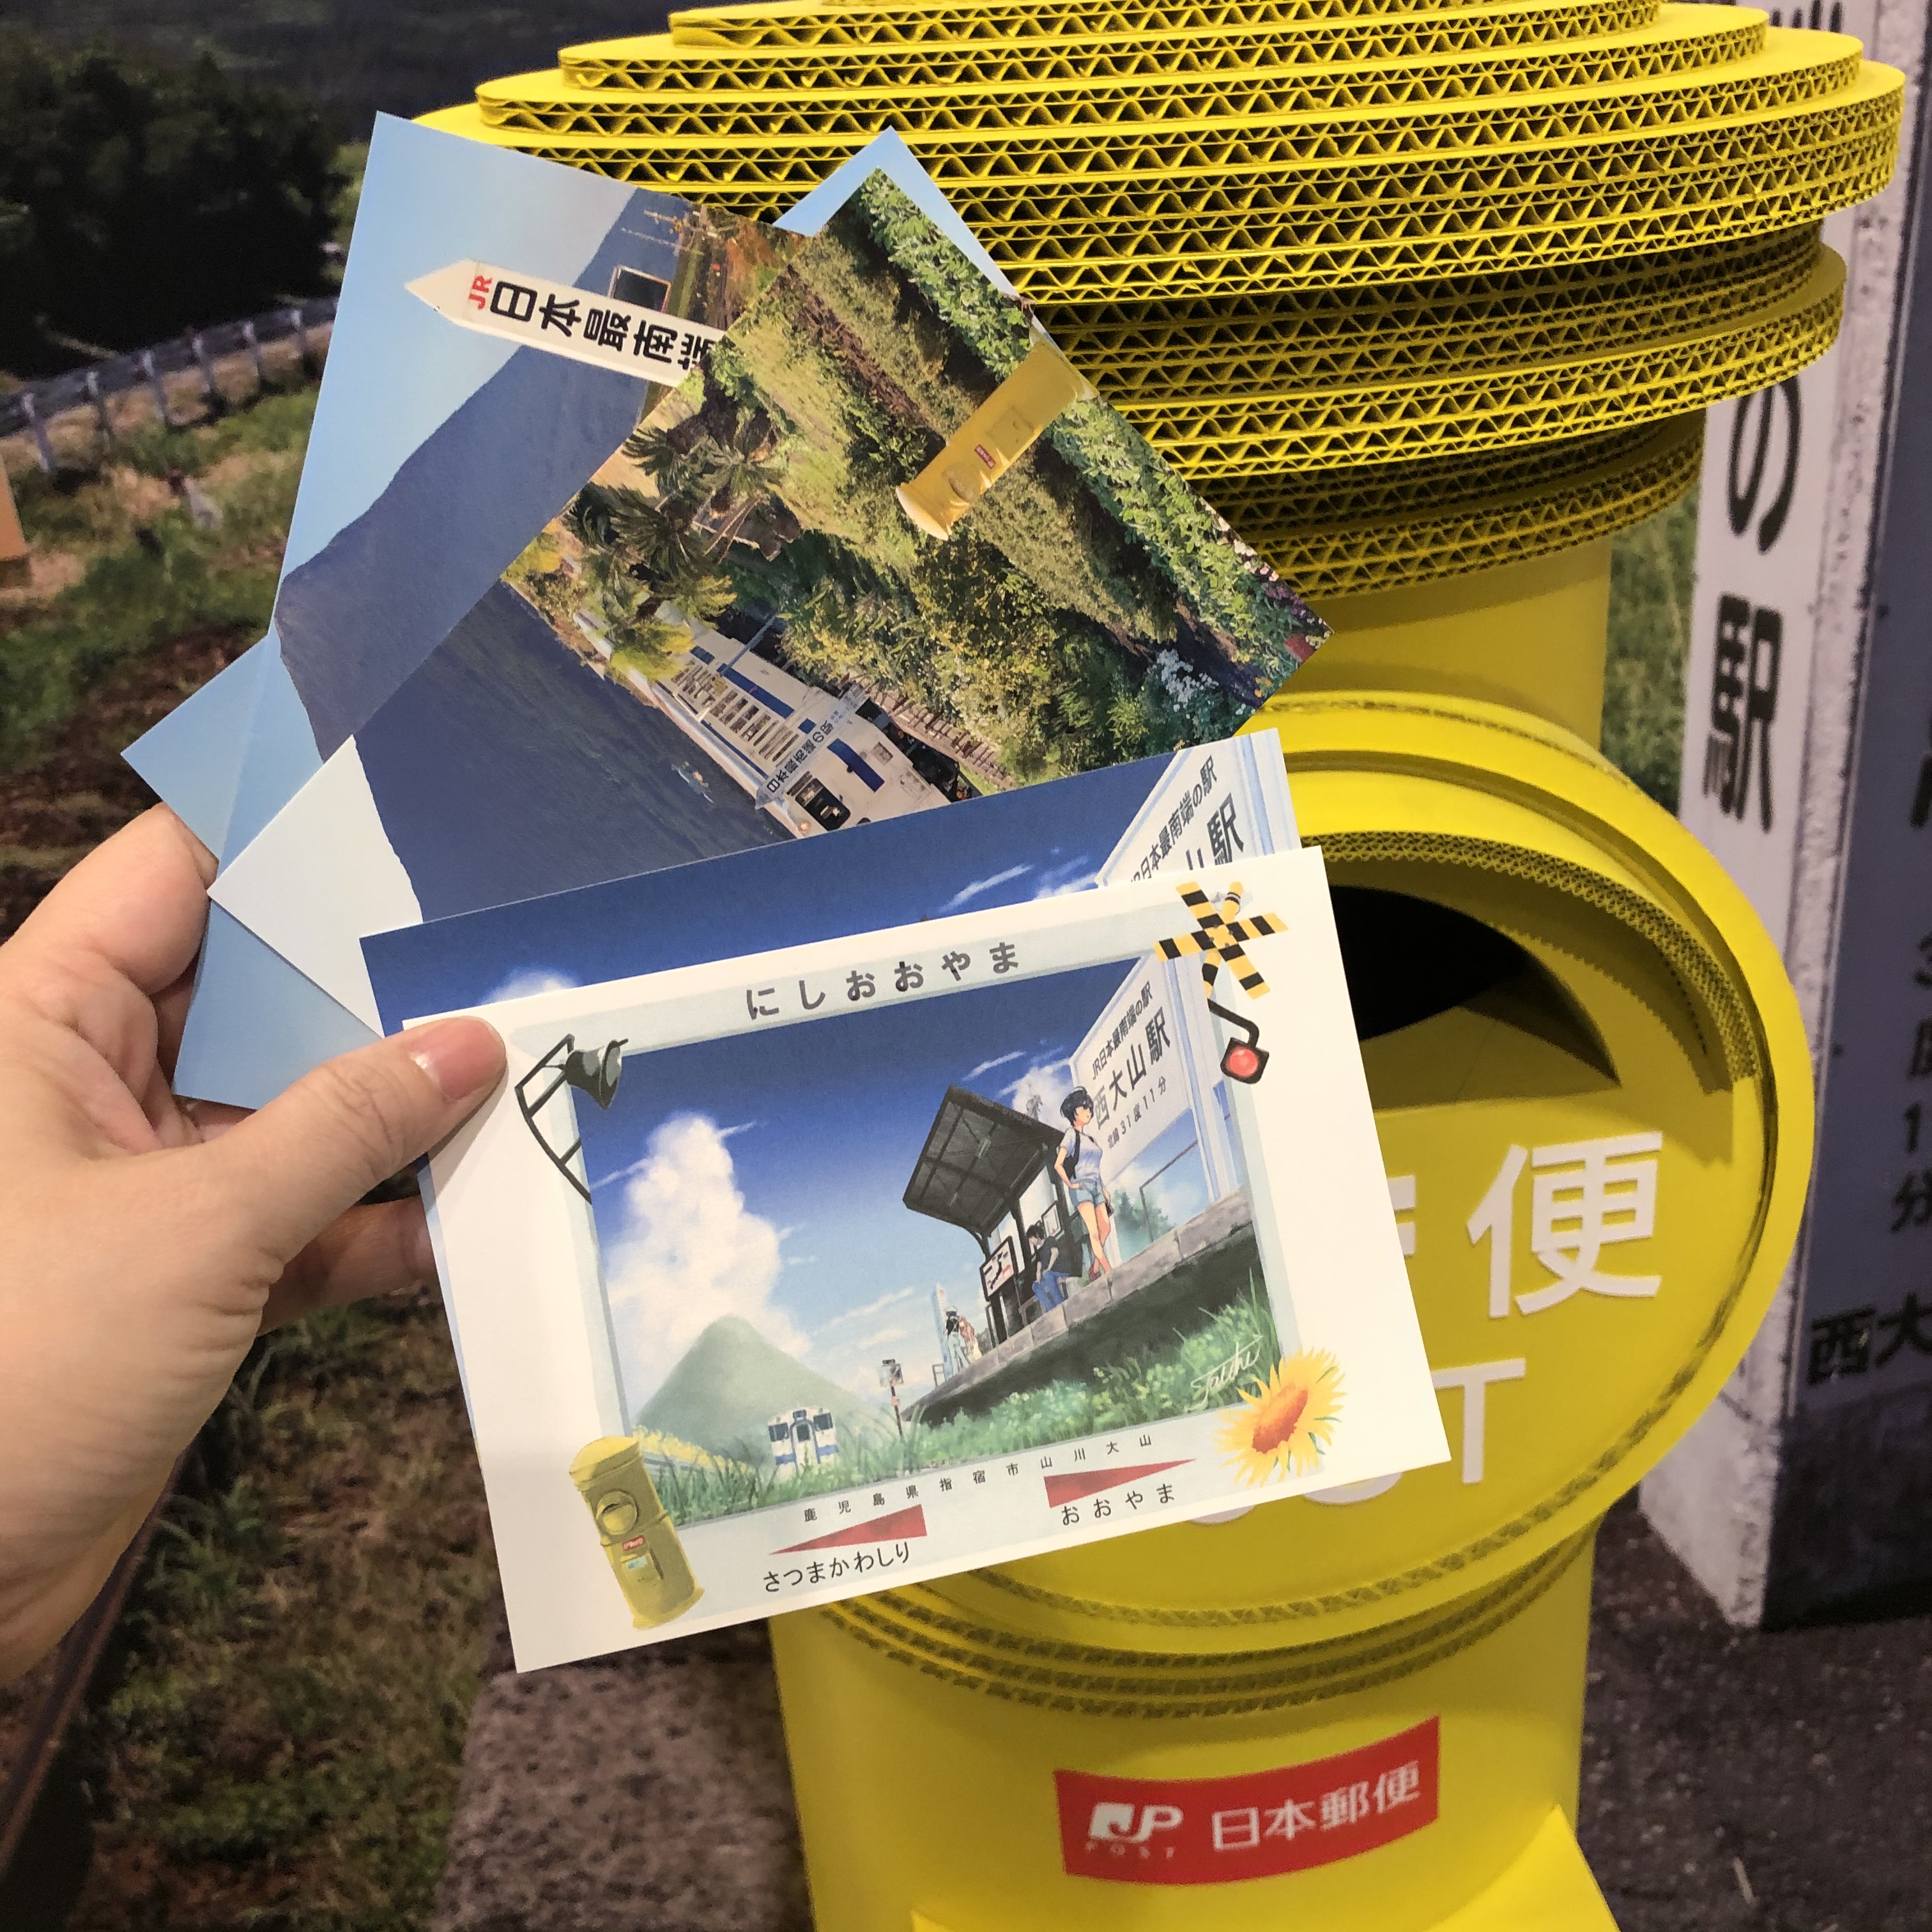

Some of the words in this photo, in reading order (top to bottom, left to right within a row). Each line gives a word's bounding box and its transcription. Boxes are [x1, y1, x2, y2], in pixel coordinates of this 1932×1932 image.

[1130, 755, 1217, 882] 日本最南端の駅
[746, 942, 1019, 1020] にしおおやま
[1092, 1006, 1170, 1130] 西大山駅
[1388, 1130, 1664, 1320] 便
[803, 1432, 1153, 1523] 鹿児島県指宿市山川大山
[1061, 1483, 1176, 1526] おおやま
[762, 1541, 910, 1593] さつまかわしり
[1212, 1761, 1420, 1851] 日本郵便
